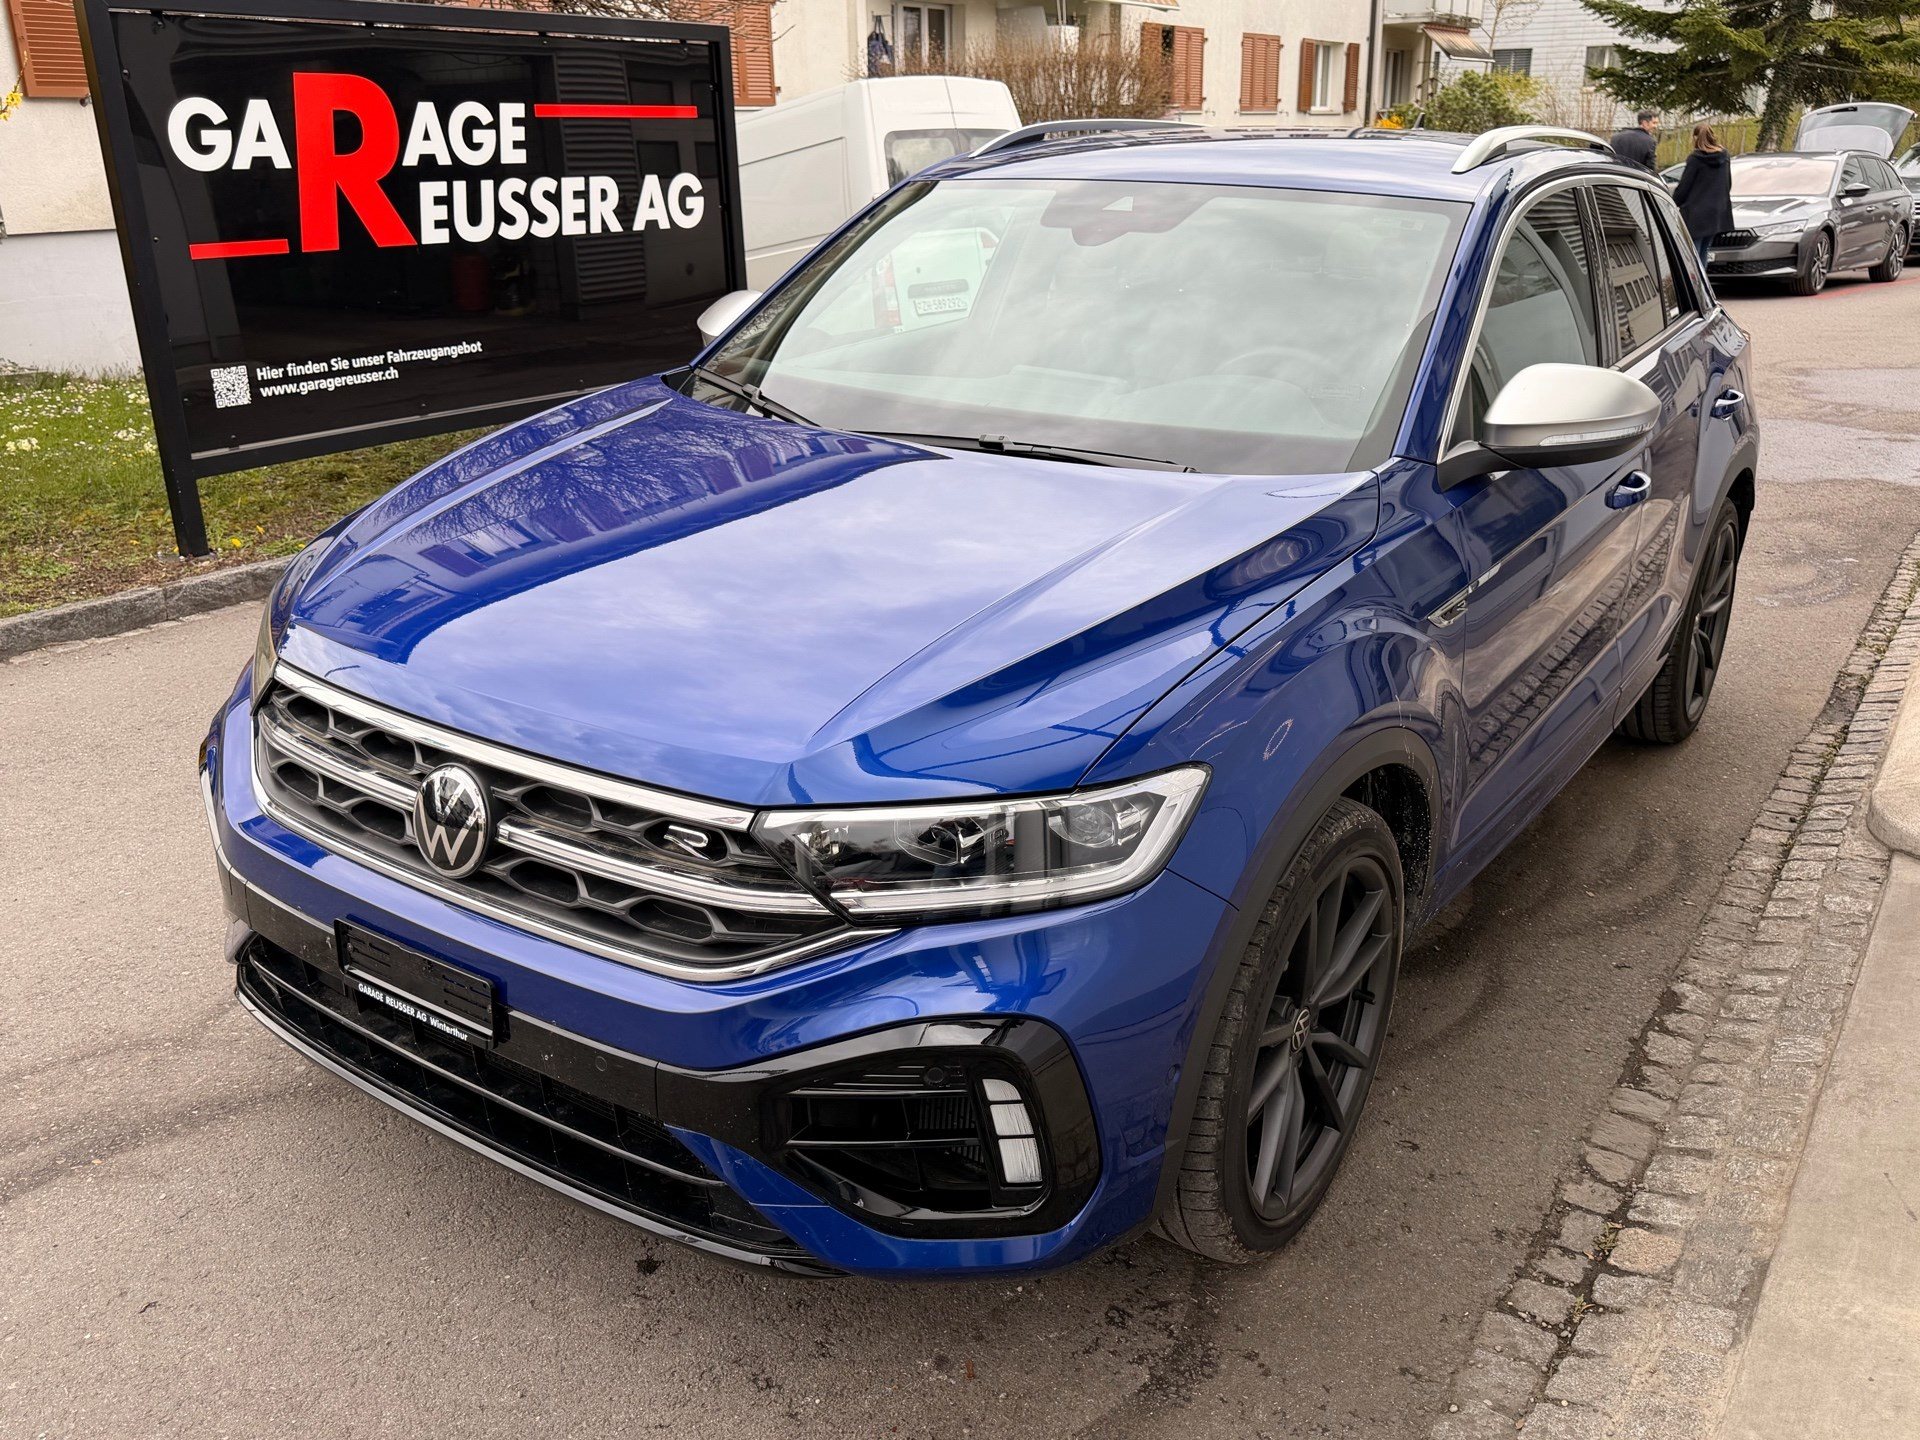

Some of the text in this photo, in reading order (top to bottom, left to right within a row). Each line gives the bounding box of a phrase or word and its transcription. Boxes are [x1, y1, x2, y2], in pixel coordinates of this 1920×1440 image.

[632, 172, 705, 231] AG
[256, 341, 483, 381] Hier finden Sie unser Fahrzeugangebot
[260, 367, 399, 397] www.garagereusser.ch
[358, 983, 468, 1041] GARAGE REUSSER AG Winterthur
